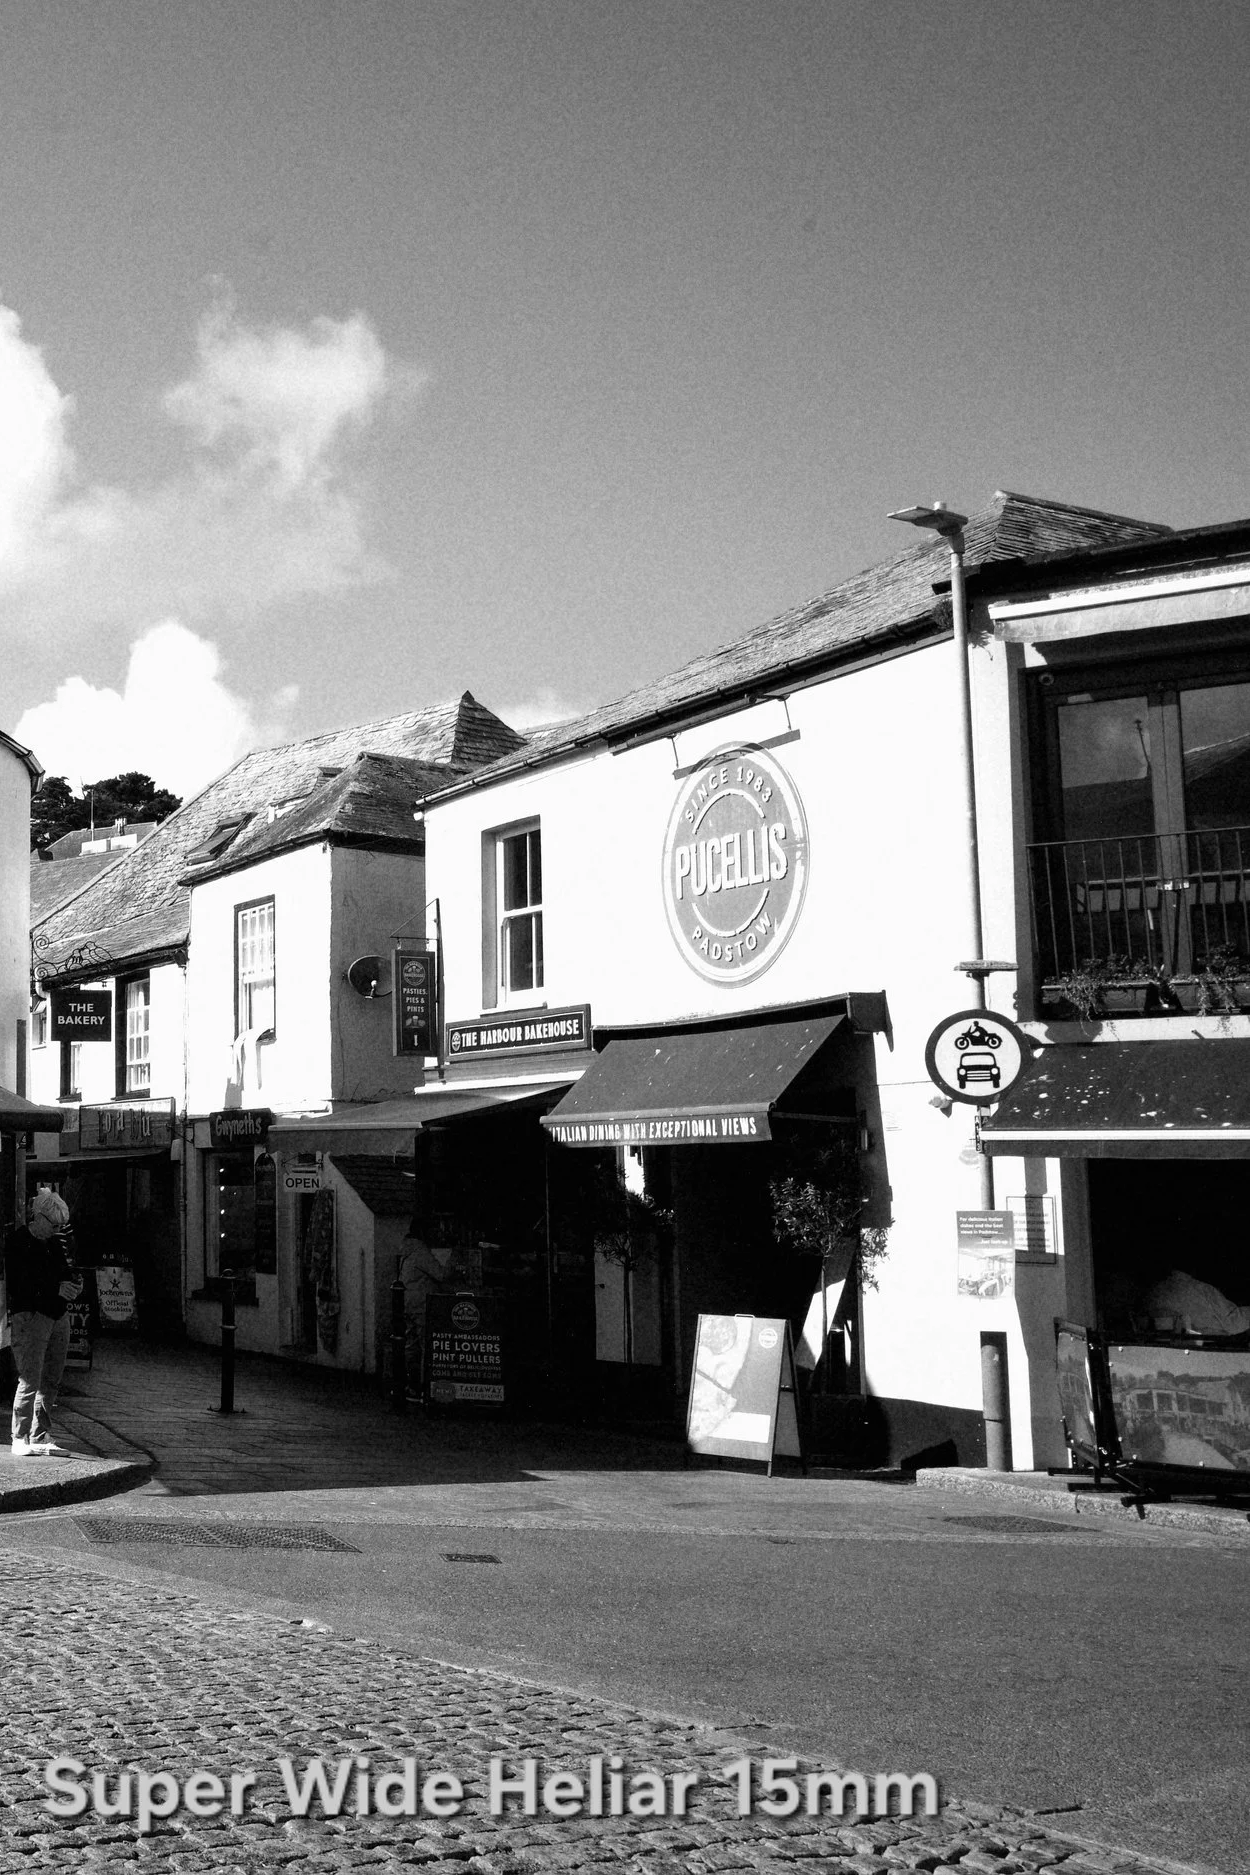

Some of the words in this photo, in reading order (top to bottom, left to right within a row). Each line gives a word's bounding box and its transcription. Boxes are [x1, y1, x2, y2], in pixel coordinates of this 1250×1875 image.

[686, 767, 730, 824] SINCE
[736, 766, 773, 804] 1983
[675, 821, 788, 901] PUCELLIS
[690, 911, 774, 962] PADSTOW
[406, 996, 419, 1004] PIES
[69, 1003, 94, 1013] THE
[406, 1005, 425, 1013] PINTS
[57, 1015, 105, 1026] BAKERY
[462, 1032, 477, 1047] THE
[480, 1026, 522, 1046] HARBOUR
[524, 1019, 579, 1041] BAKEHOUSE
[589, 1123, 620, 1141] DINING
[622, 1122, 646, 1140] WITH
[648, 1118, 718, 1139] EXCEPTIONAL
[721, 1116, 757, 1136] VIEWS
[285, 1177, 320, 1189] OPEN
[432, 1332, 452, 1340] PASTY
[453, 1333, 501, 1342] AMBASSADORS
[432, 1341, 451, 1351] PIE
[455, 1341, 501, 1353] LOVERS
[432, 1352, 456, 1362] PINT
[459, 1353, 501, 1364] PULLERS
[460, 1385, 502, 1393] TAKEAWAY
